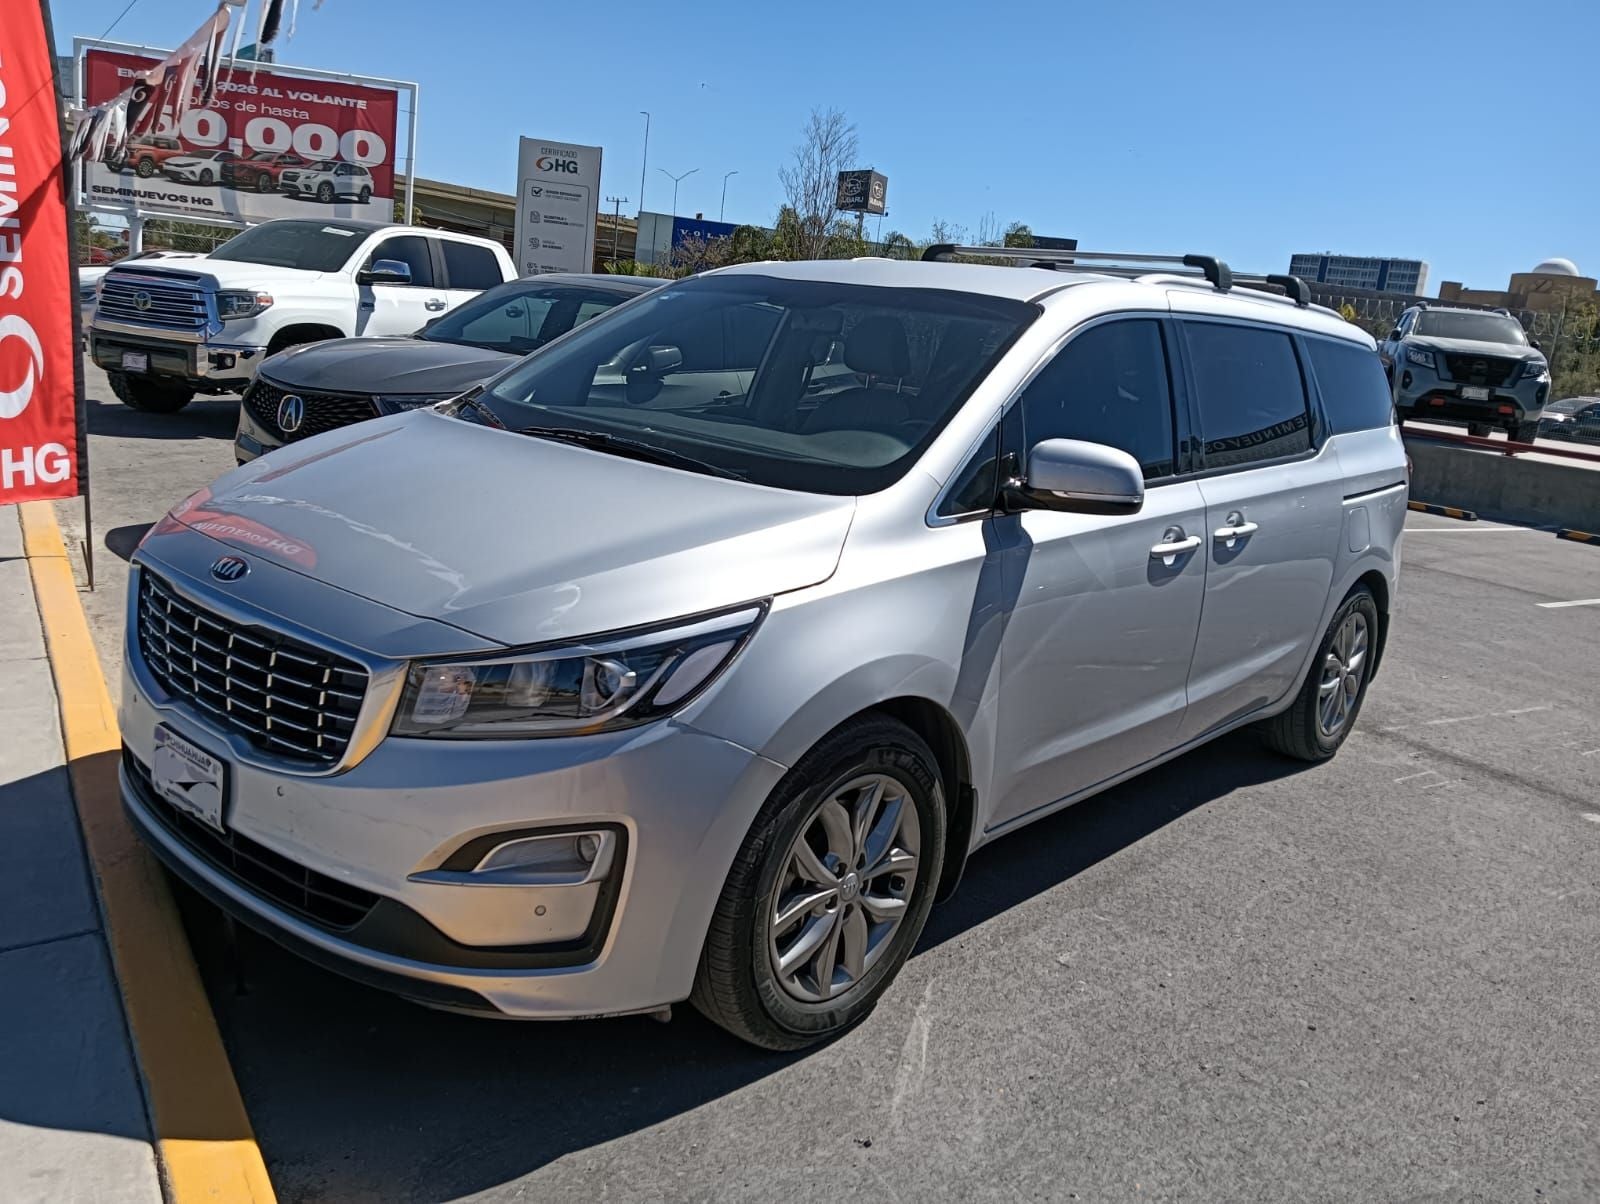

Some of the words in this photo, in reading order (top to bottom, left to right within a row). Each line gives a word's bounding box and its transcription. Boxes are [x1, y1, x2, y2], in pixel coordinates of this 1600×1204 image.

[217, 81, 258, 95] 2026
[261, 87, 283, 98] AL
[287, 90, 367, 109] VOLANTE
[234, 100, 257, 113] de
[261, 102, 310, 120] hasta
[554, 158, 578, 174] HG
[92, 184, 189, 203] SEMINUEVOS
[191, 196, 214, 206] HG
[2, 442, 71, 489] HG
[213, 556, 244, 580] KIA
